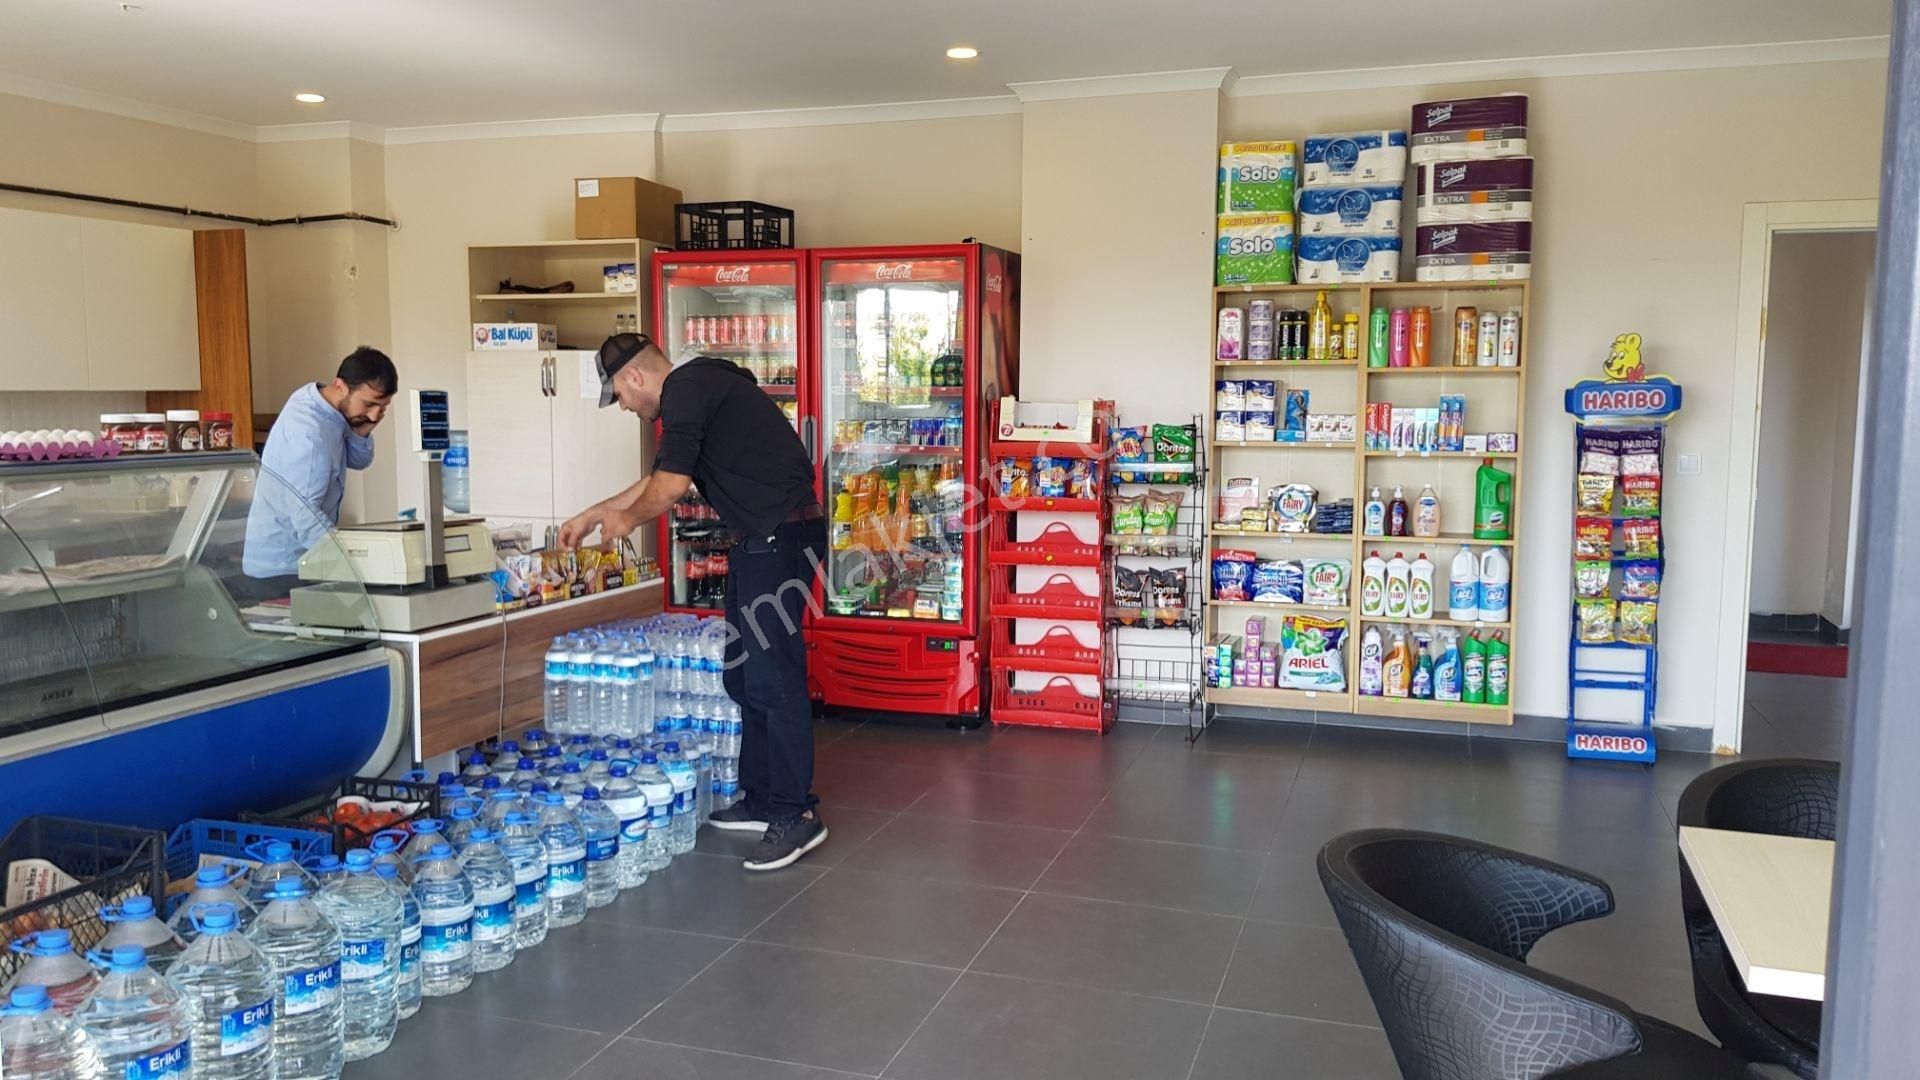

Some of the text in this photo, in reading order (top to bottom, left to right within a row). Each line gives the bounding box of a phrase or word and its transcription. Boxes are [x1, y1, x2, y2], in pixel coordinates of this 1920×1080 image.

[1426, 103, 1453, 118] Selpak
[1424, 135, 1451, 143] EXTRA
[1239, 165, 1280, 182] Solo
[1440, 164, 1467, 178] Selpak
[1432, 227, 1458, 240] Selpak
[1229, 235, 1275, 256] Solo
[1429, 257, 1456, 265] EXTRA
[491, 327, 506, 340] Bal
[508, 326, 533, 342] Küpü
[1584, 390, 1666, 410] HARIBO
[1156, 442, 1190, 453] Doritos
[1585, 437, 1620, 450] HARIBO
[1622, 439, 1659, 449] HARIBO
[1282, 499, 1304, 510] FAIRY
[1315, 572, 1337, 583] FAIRY
[1288, 657, 1329, 669] ARIEL
[1576, 735, 1647, 754] HARIBO
[551, 865, 574, 877] Erikli
[445, 923, 469, 938] Erikli
[305, 967, 334, 987] Erikli
[243, 1002, 270, 1025] Erikli
[149, 1047, 182, 1072] Erikli
